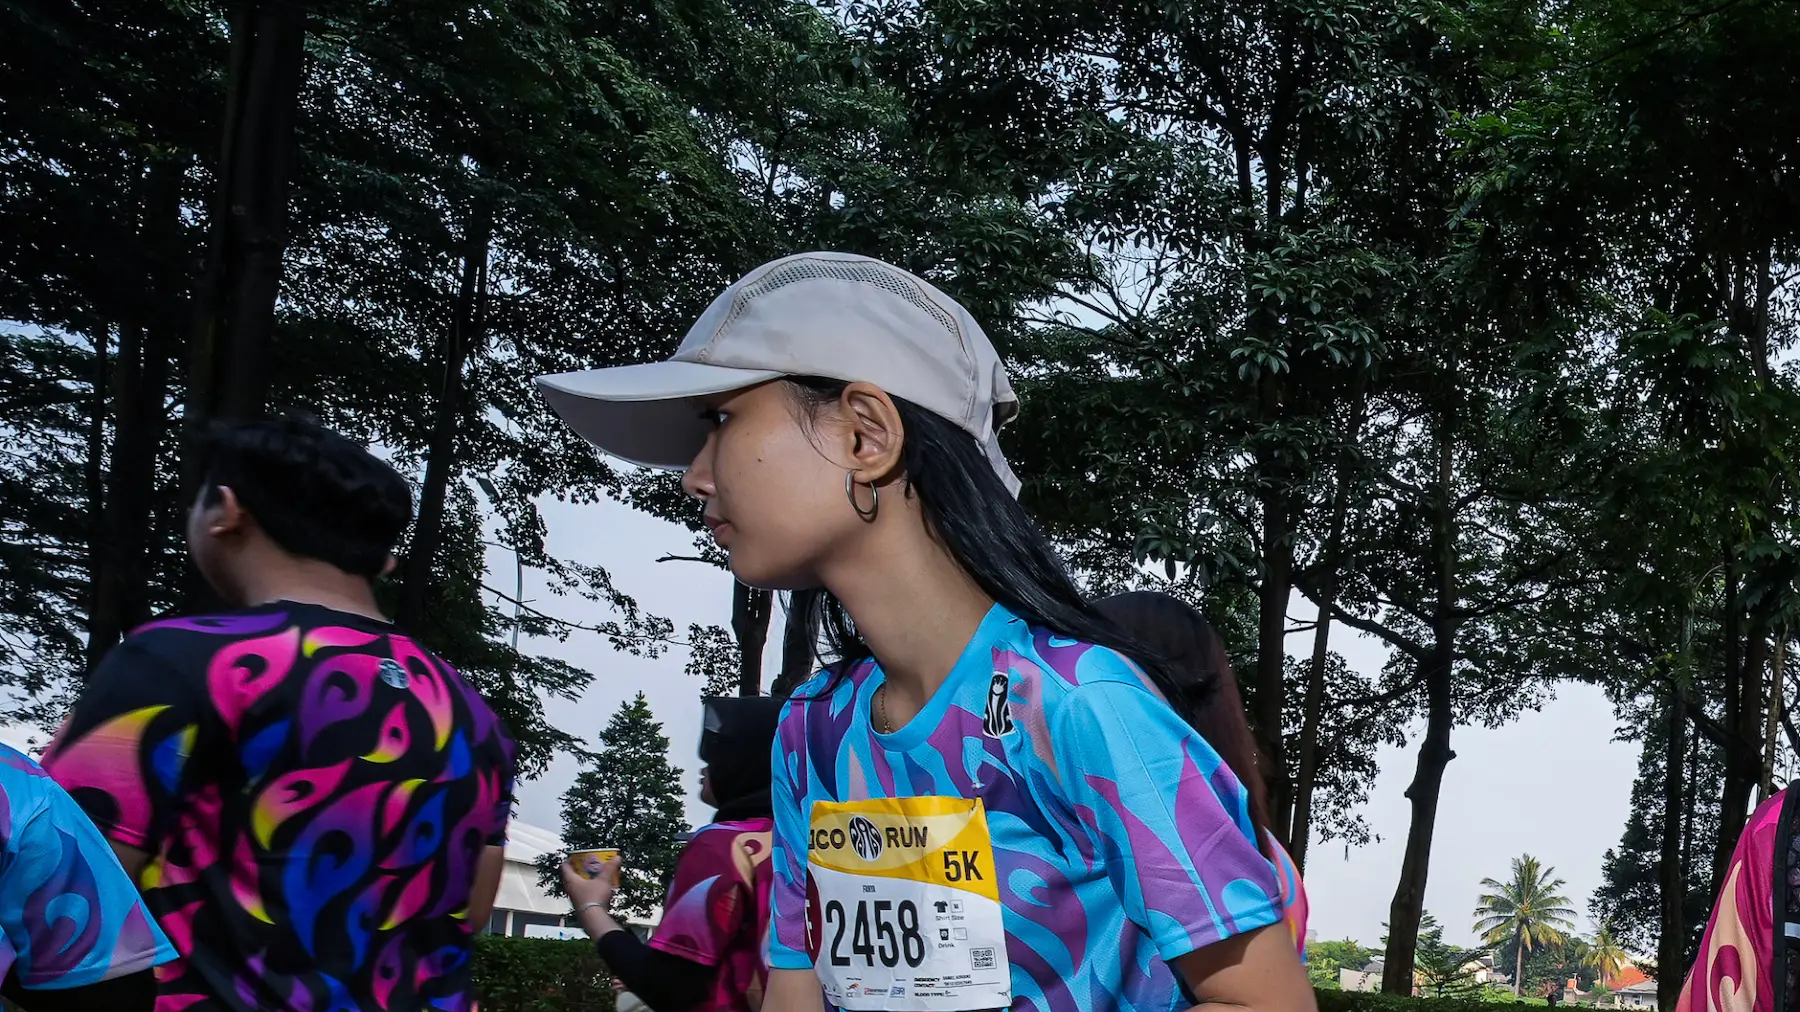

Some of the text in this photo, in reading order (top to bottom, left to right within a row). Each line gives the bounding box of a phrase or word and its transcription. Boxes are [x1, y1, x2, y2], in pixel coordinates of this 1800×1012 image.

[885, 826, 928, 848] RUN
[943, 850, 984, 882] 5K
[825, 899, 926, 968] 2458
